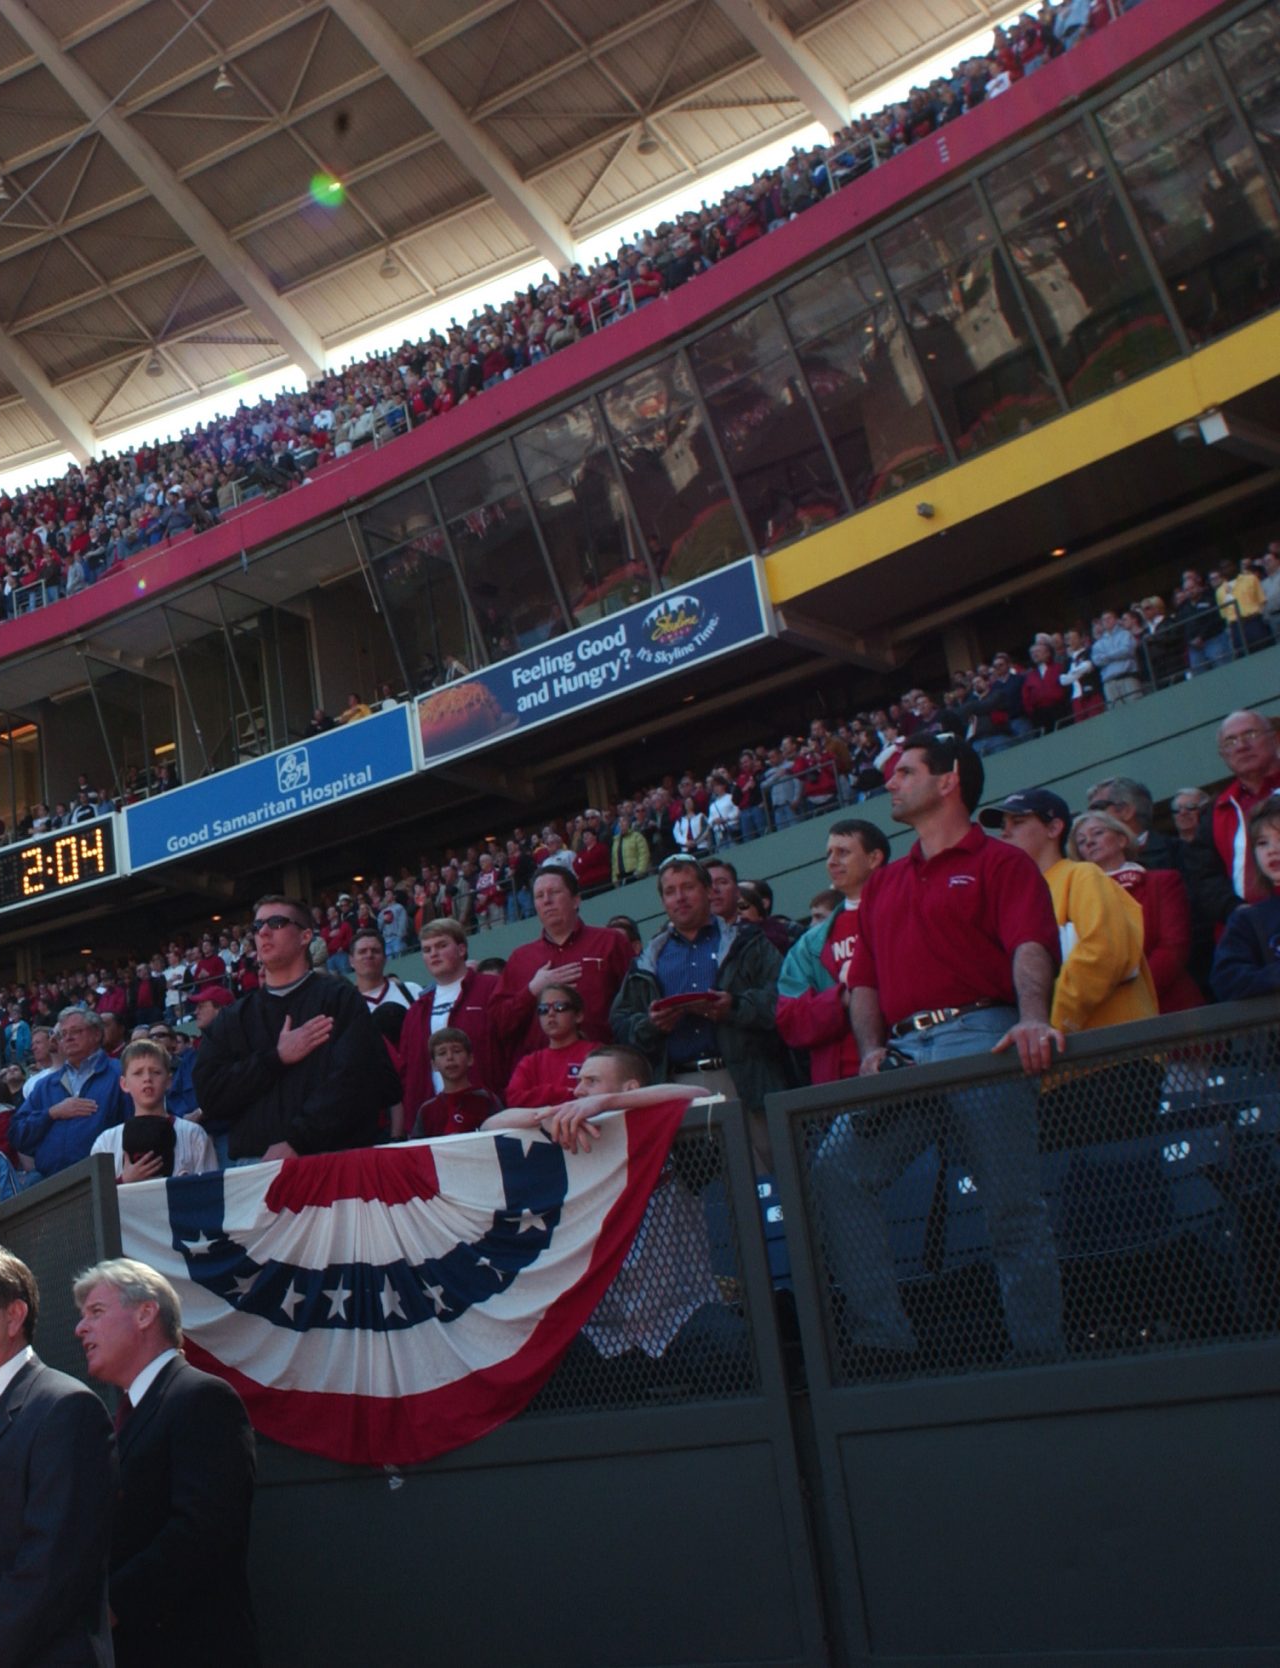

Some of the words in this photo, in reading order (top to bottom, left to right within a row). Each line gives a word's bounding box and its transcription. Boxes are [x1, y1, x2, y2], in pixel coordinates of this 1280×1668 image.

[512, 655, 576, 688] Feeling
[577, 624, 627, 660] Good
[517, 681, 549, 712] and
[553, 648, 631, 698] Hungry?
[654, 642, 695, 665] Skyline
[166, 824, 209, 852] Good
[213, 797, 297, 836] Samaritan
[301, 765, 372, 806] Hospital
[21, 828, 105, 896] 2:04
